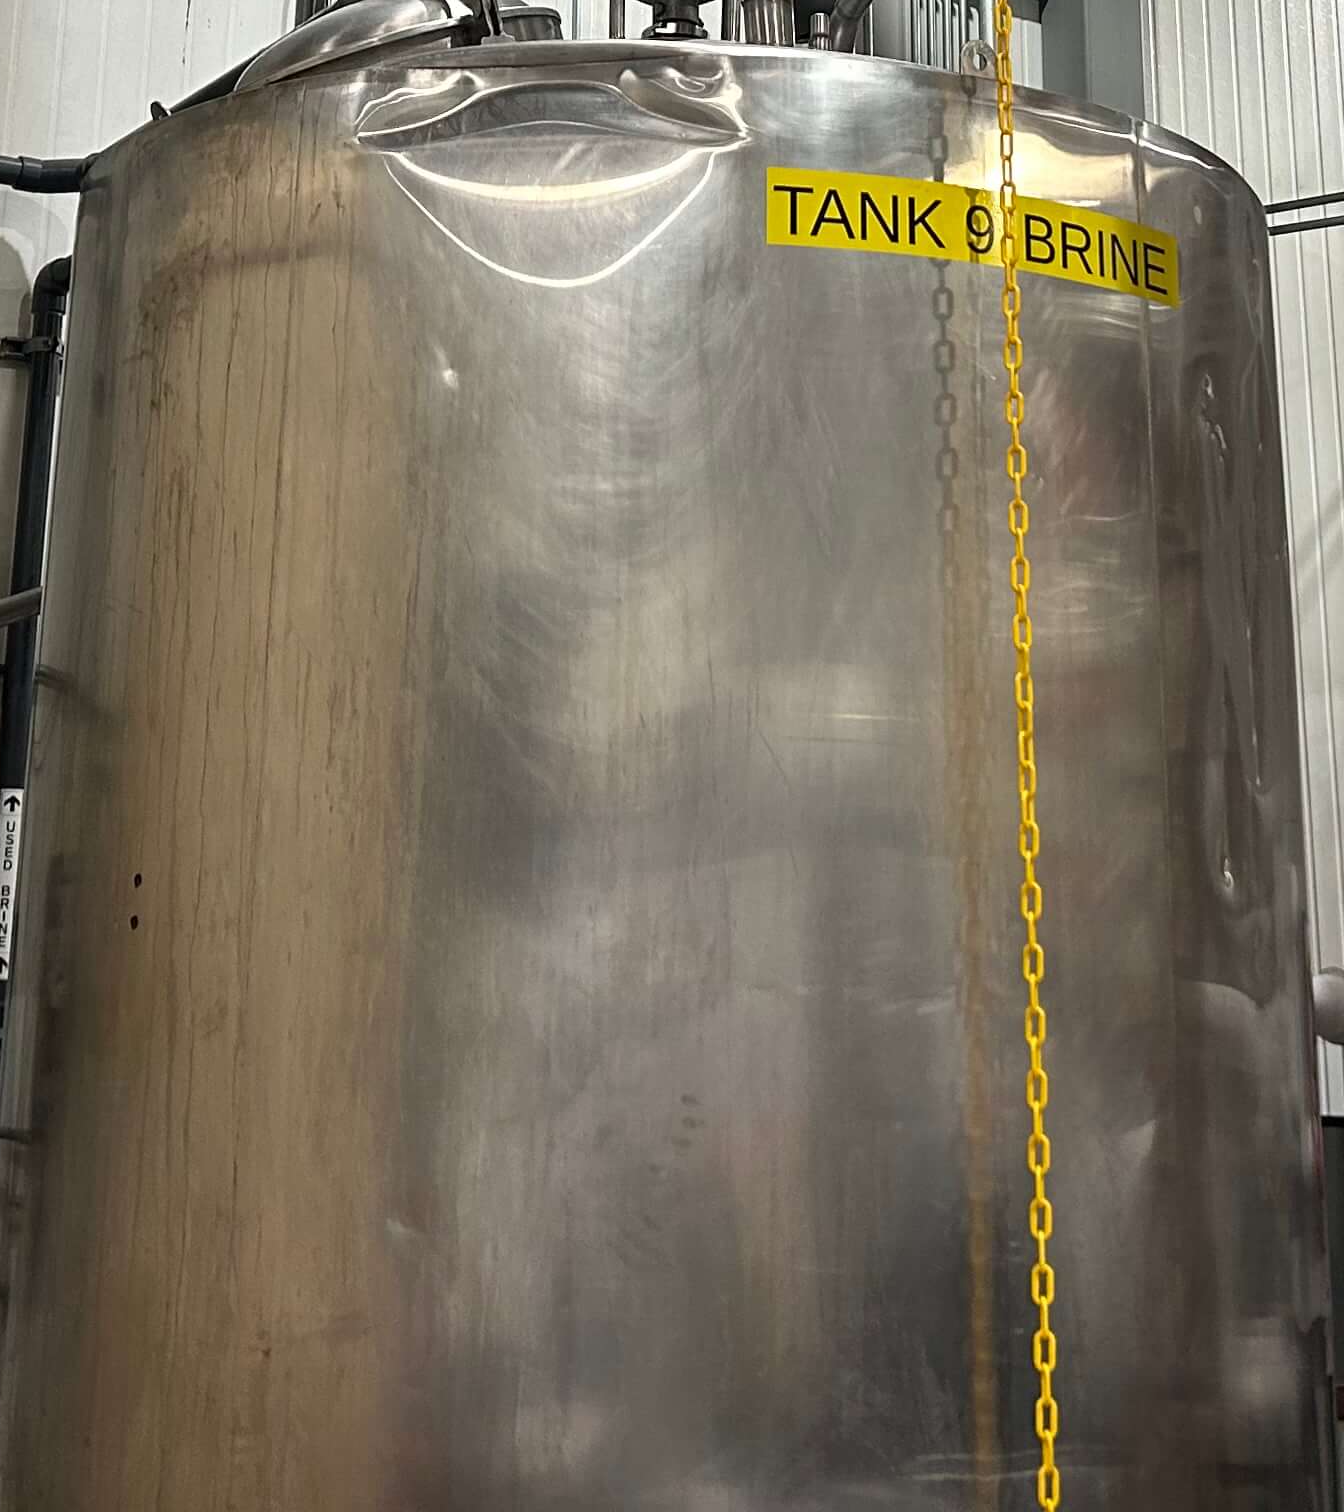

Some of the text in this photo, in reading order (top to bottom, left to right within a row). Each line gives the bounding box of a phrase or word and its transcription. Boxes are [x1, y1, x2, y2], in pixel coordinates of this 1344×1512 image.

[773, 184, 1169, 297] TANK 9 BRINE
[3, 820, 16, 872] USED
